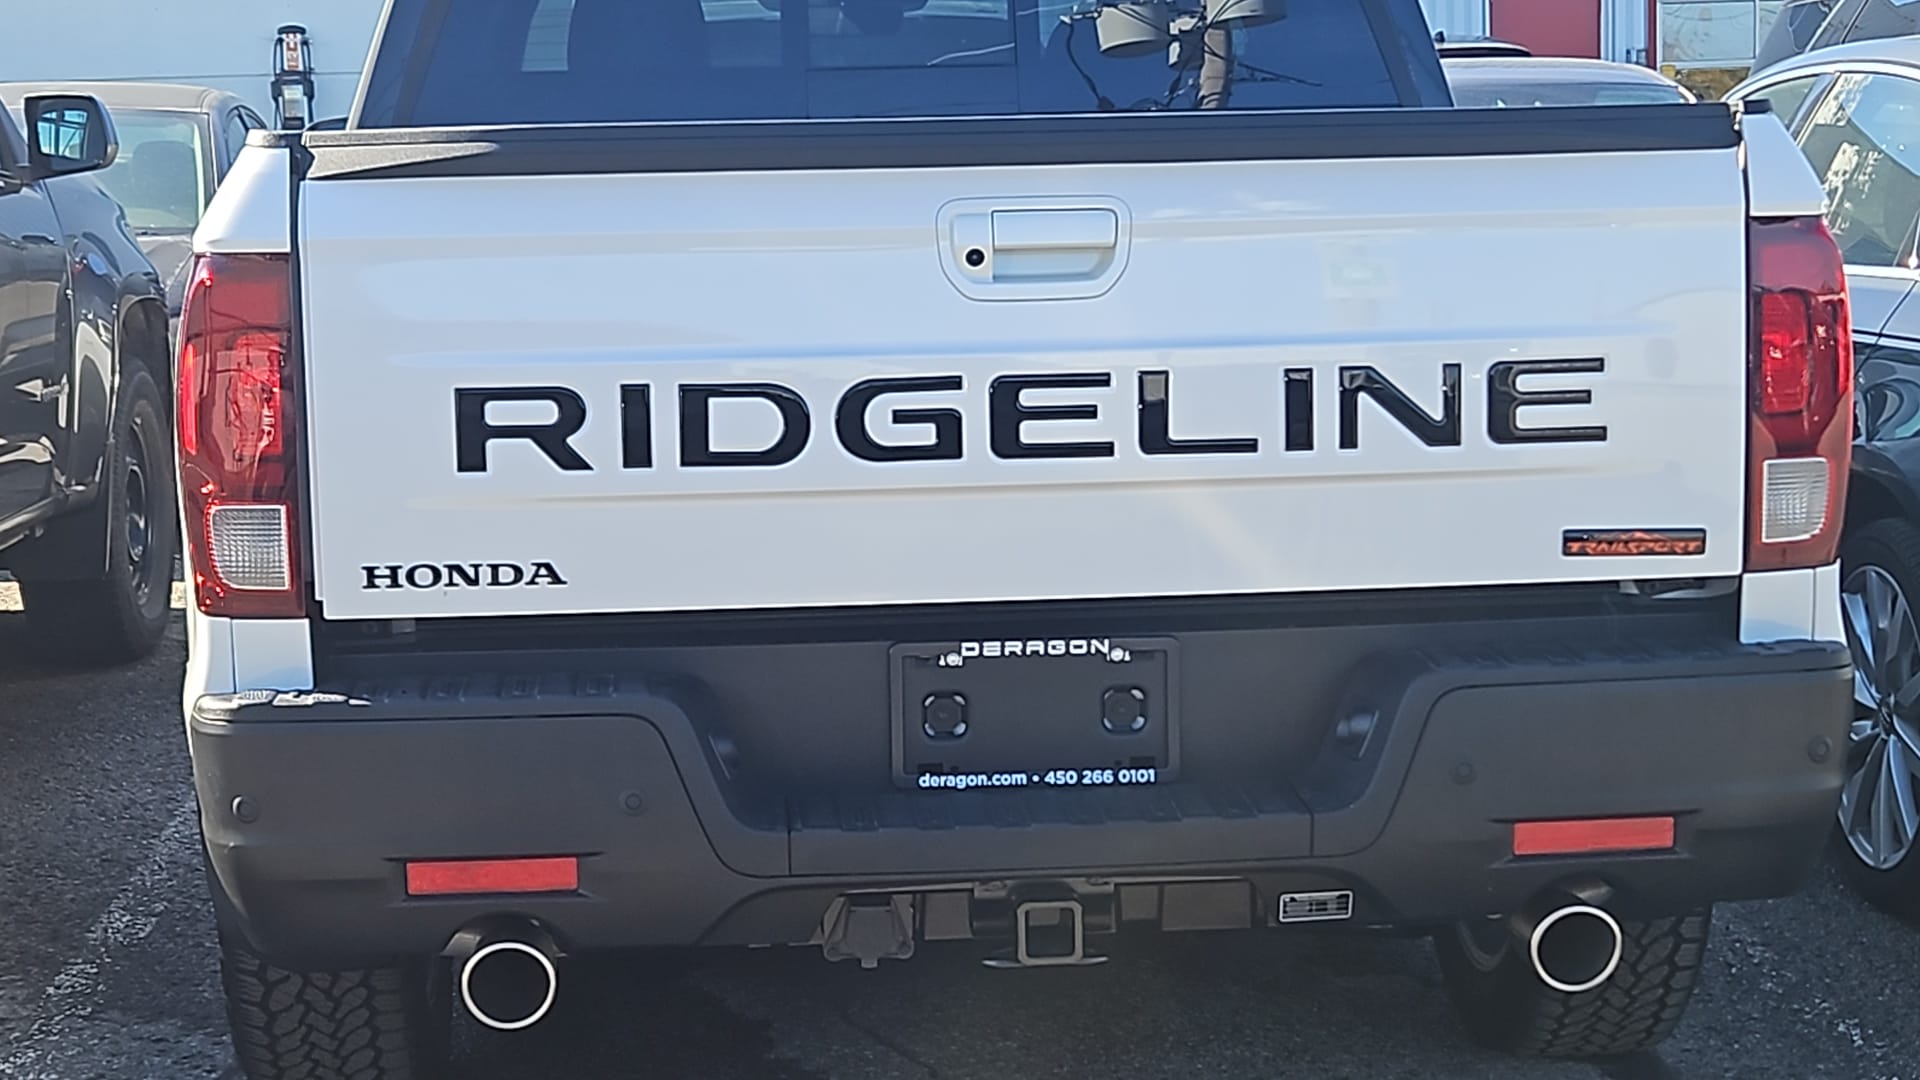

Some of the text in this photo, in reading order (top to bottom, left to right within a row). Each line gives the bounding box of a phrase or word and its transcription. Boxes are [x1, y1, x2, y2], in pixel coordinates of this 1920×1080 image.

[453, 357, 1608, 473] RIDGELINE
[1566, 540, 1703, 555] TRAILSPORT
[360, 561, 569, 590] HONDA
[960, 638, 1110, 657] DERAGON
[918, 768, 1157, 790] deragon.com 450 266 0101
